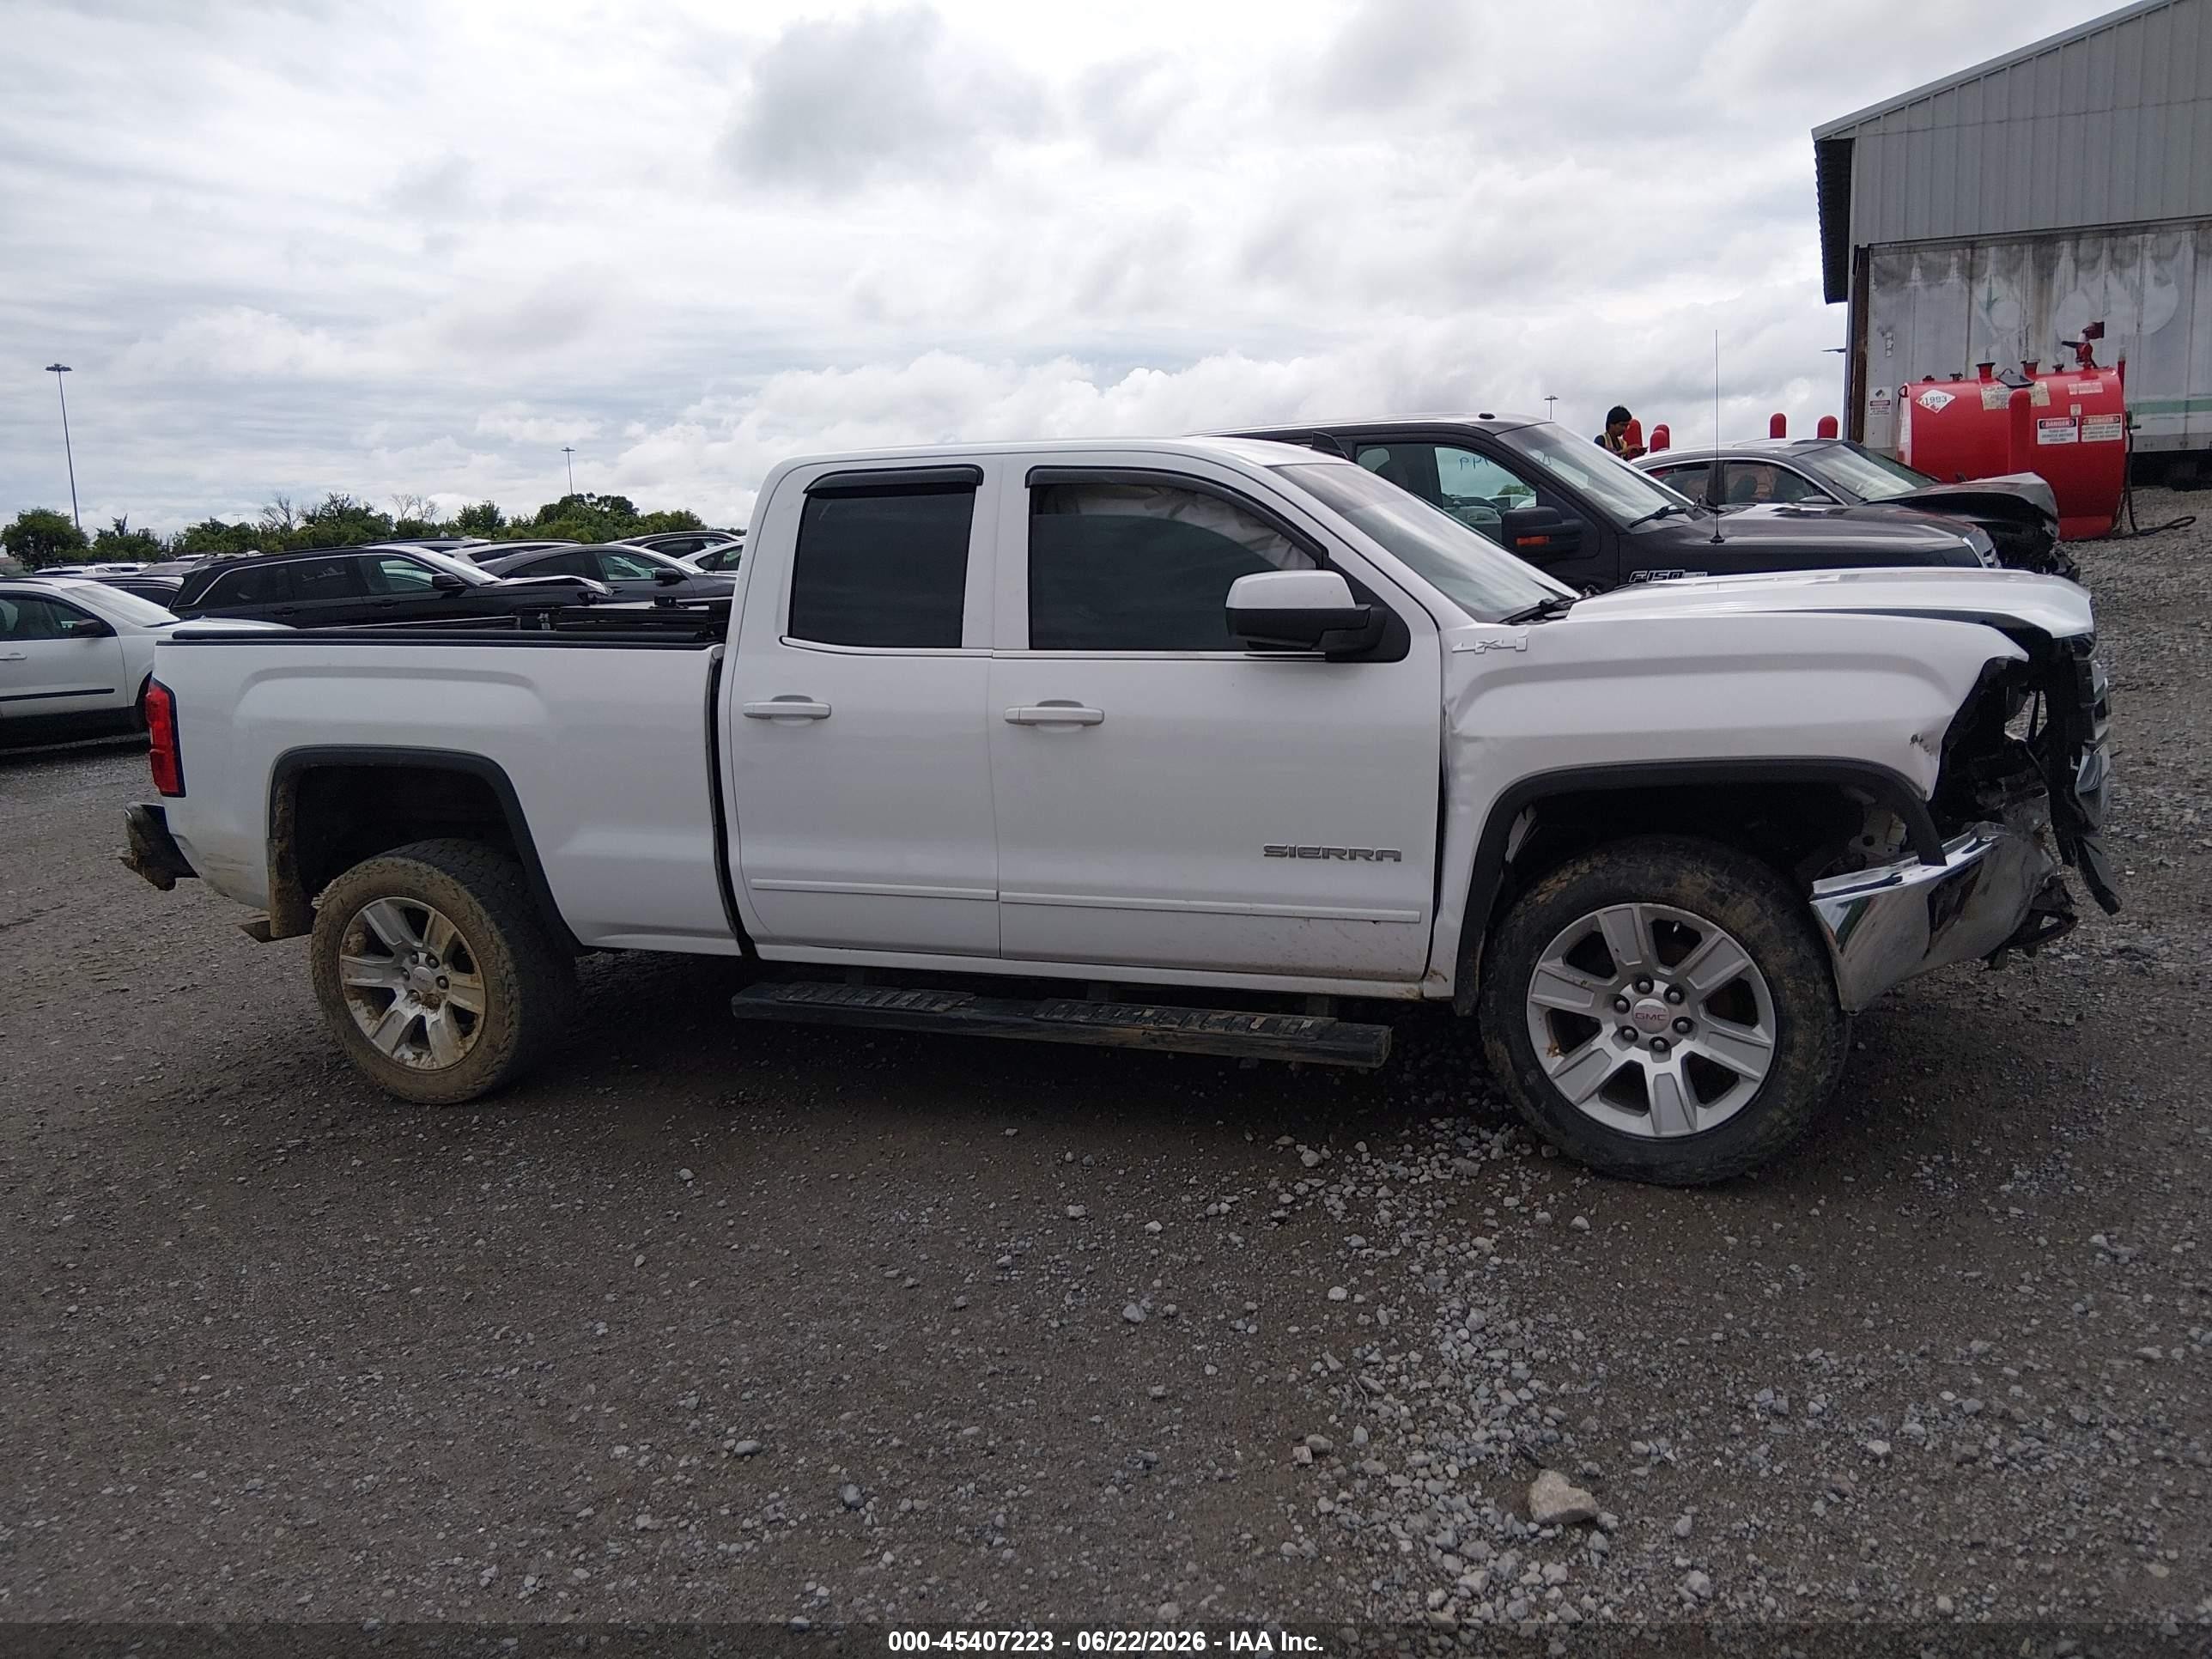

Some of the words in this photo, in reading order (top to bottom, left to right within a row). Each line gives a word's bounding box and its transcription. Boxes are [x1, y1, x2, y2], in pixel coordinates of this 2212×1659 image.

[2045, 419, 2070, 428] DANGER
[2088, 416, 2114, 425] DANGER
[1263, 843, 1402, 862] SIERRA
[1635, 1012, 1668, 1022] GMC
